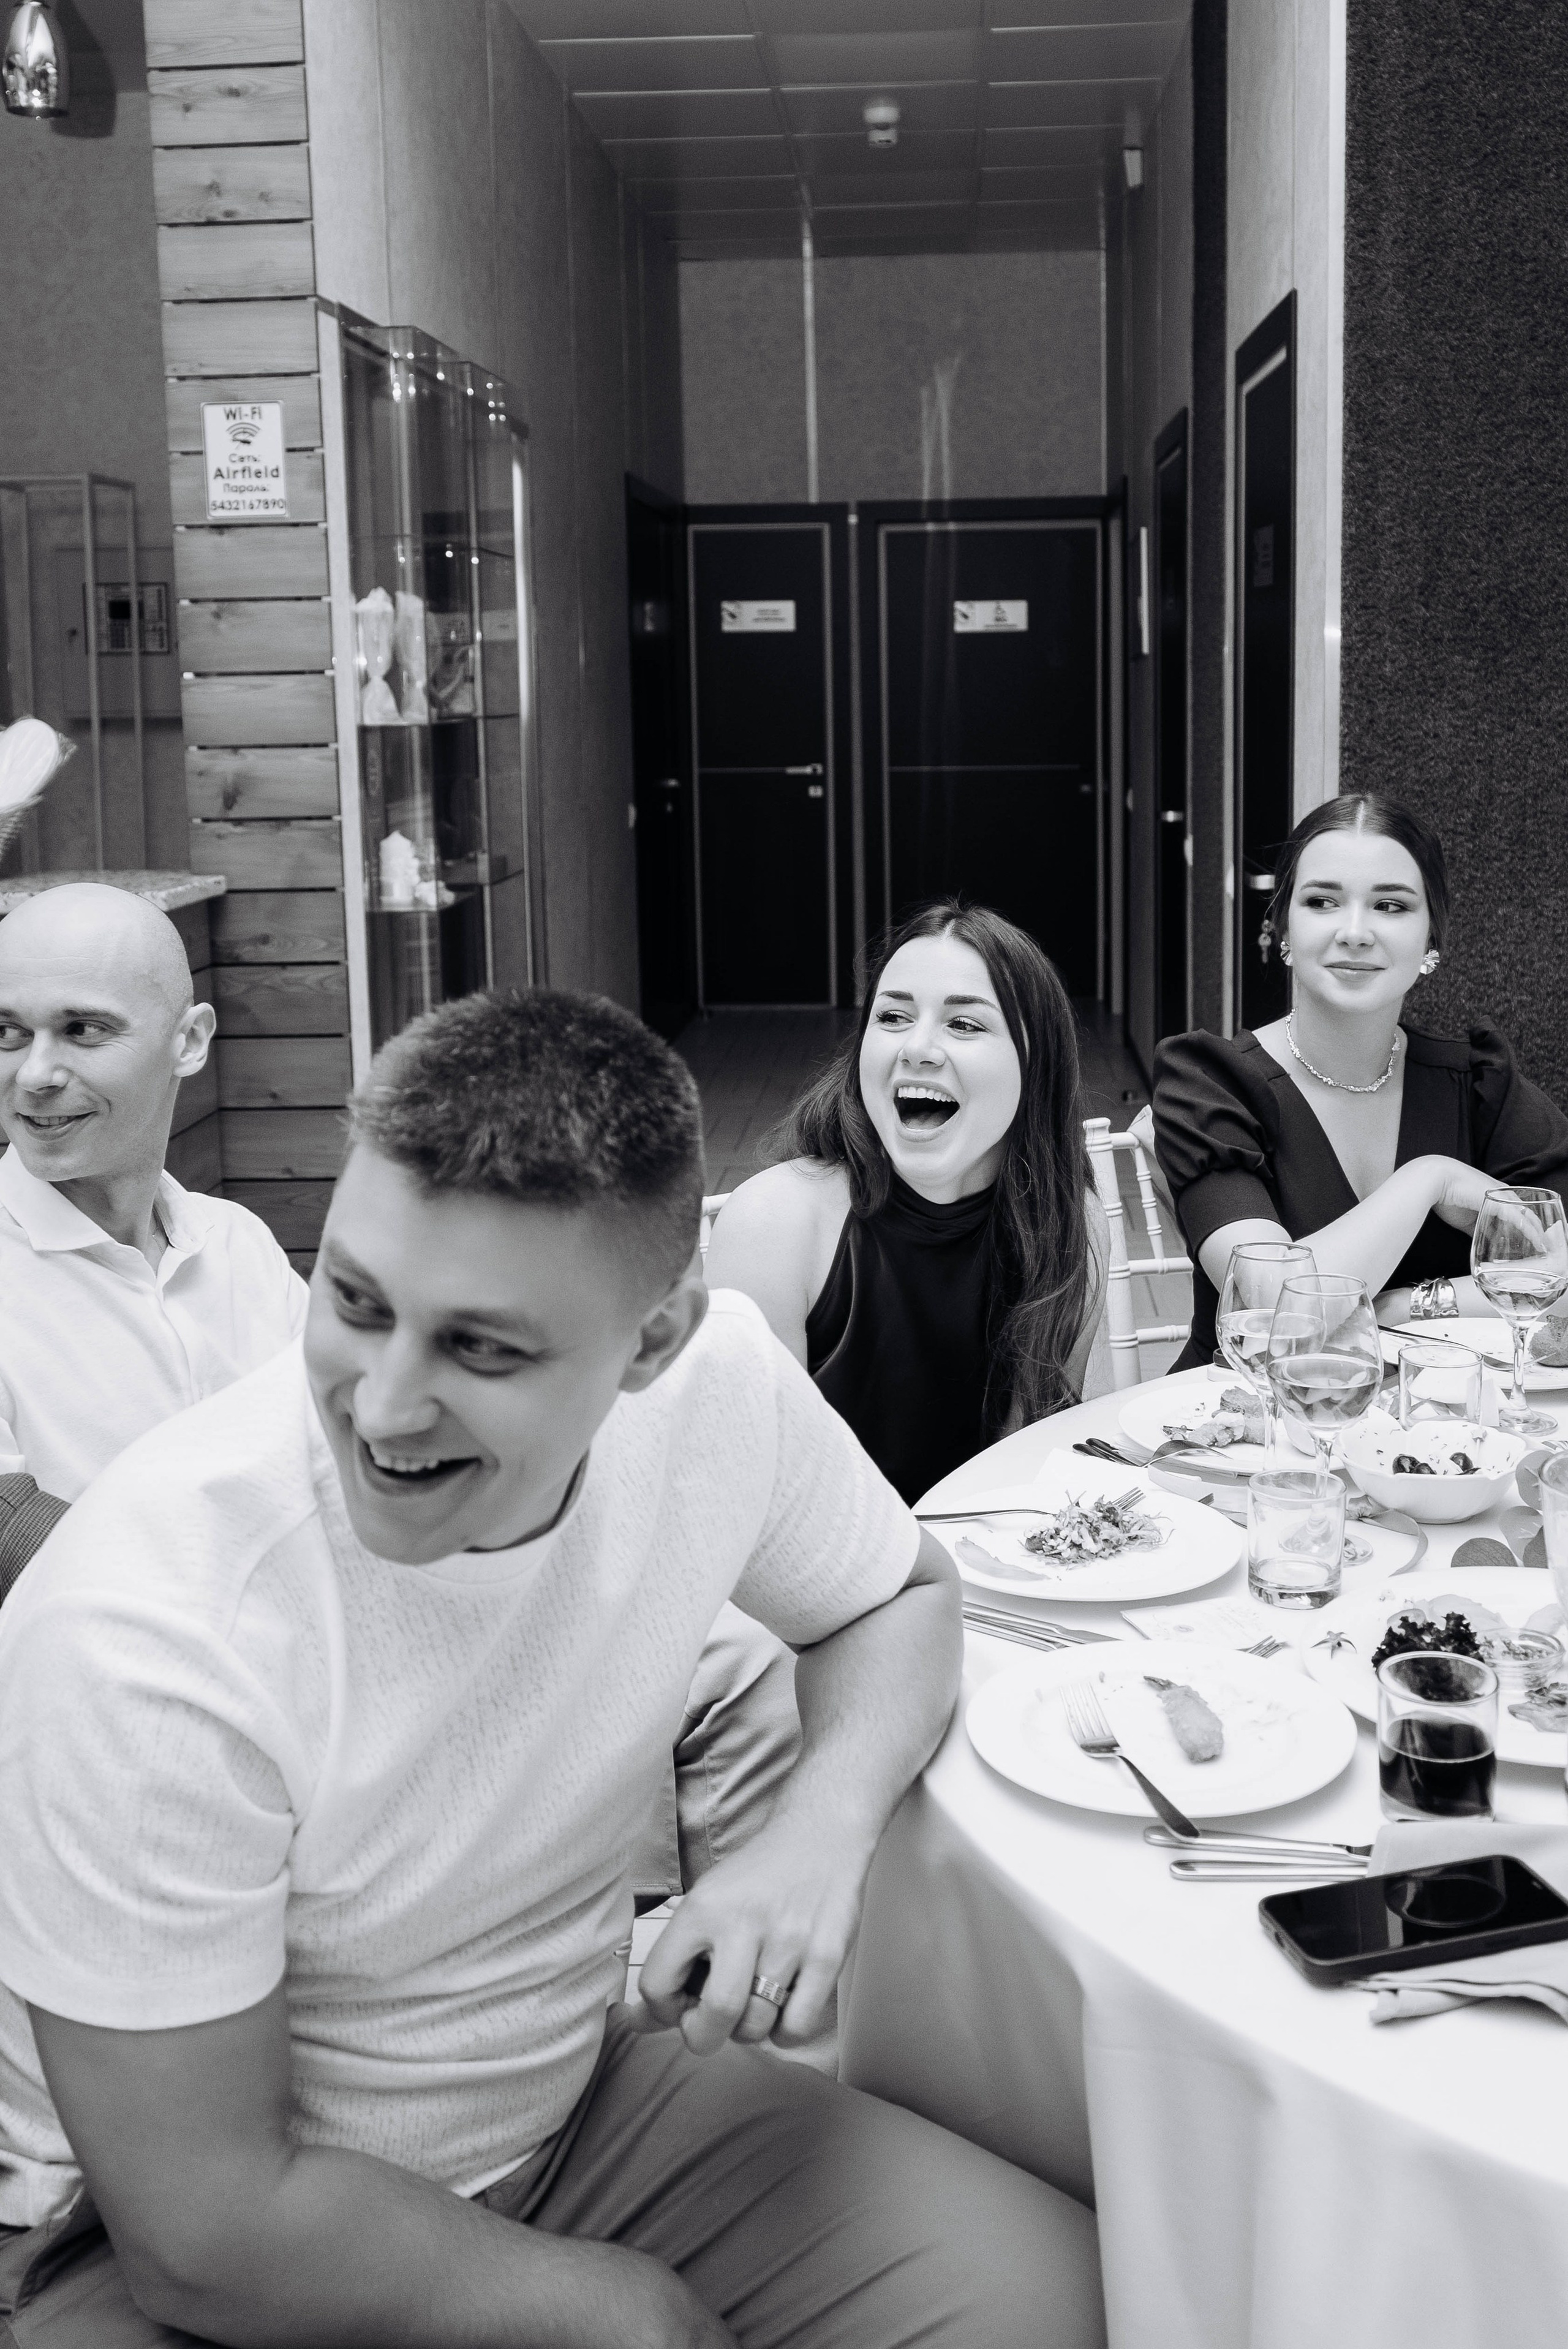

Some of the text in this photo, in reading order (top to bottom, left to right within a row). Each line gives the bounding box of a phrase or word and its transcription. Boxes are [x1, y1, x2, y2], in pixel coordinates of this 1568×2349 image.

[213, 466, 279, 480] Airfield
[223, 483, 270, 494] Пароль:
[210, 499, 285, 511] 5432167890
